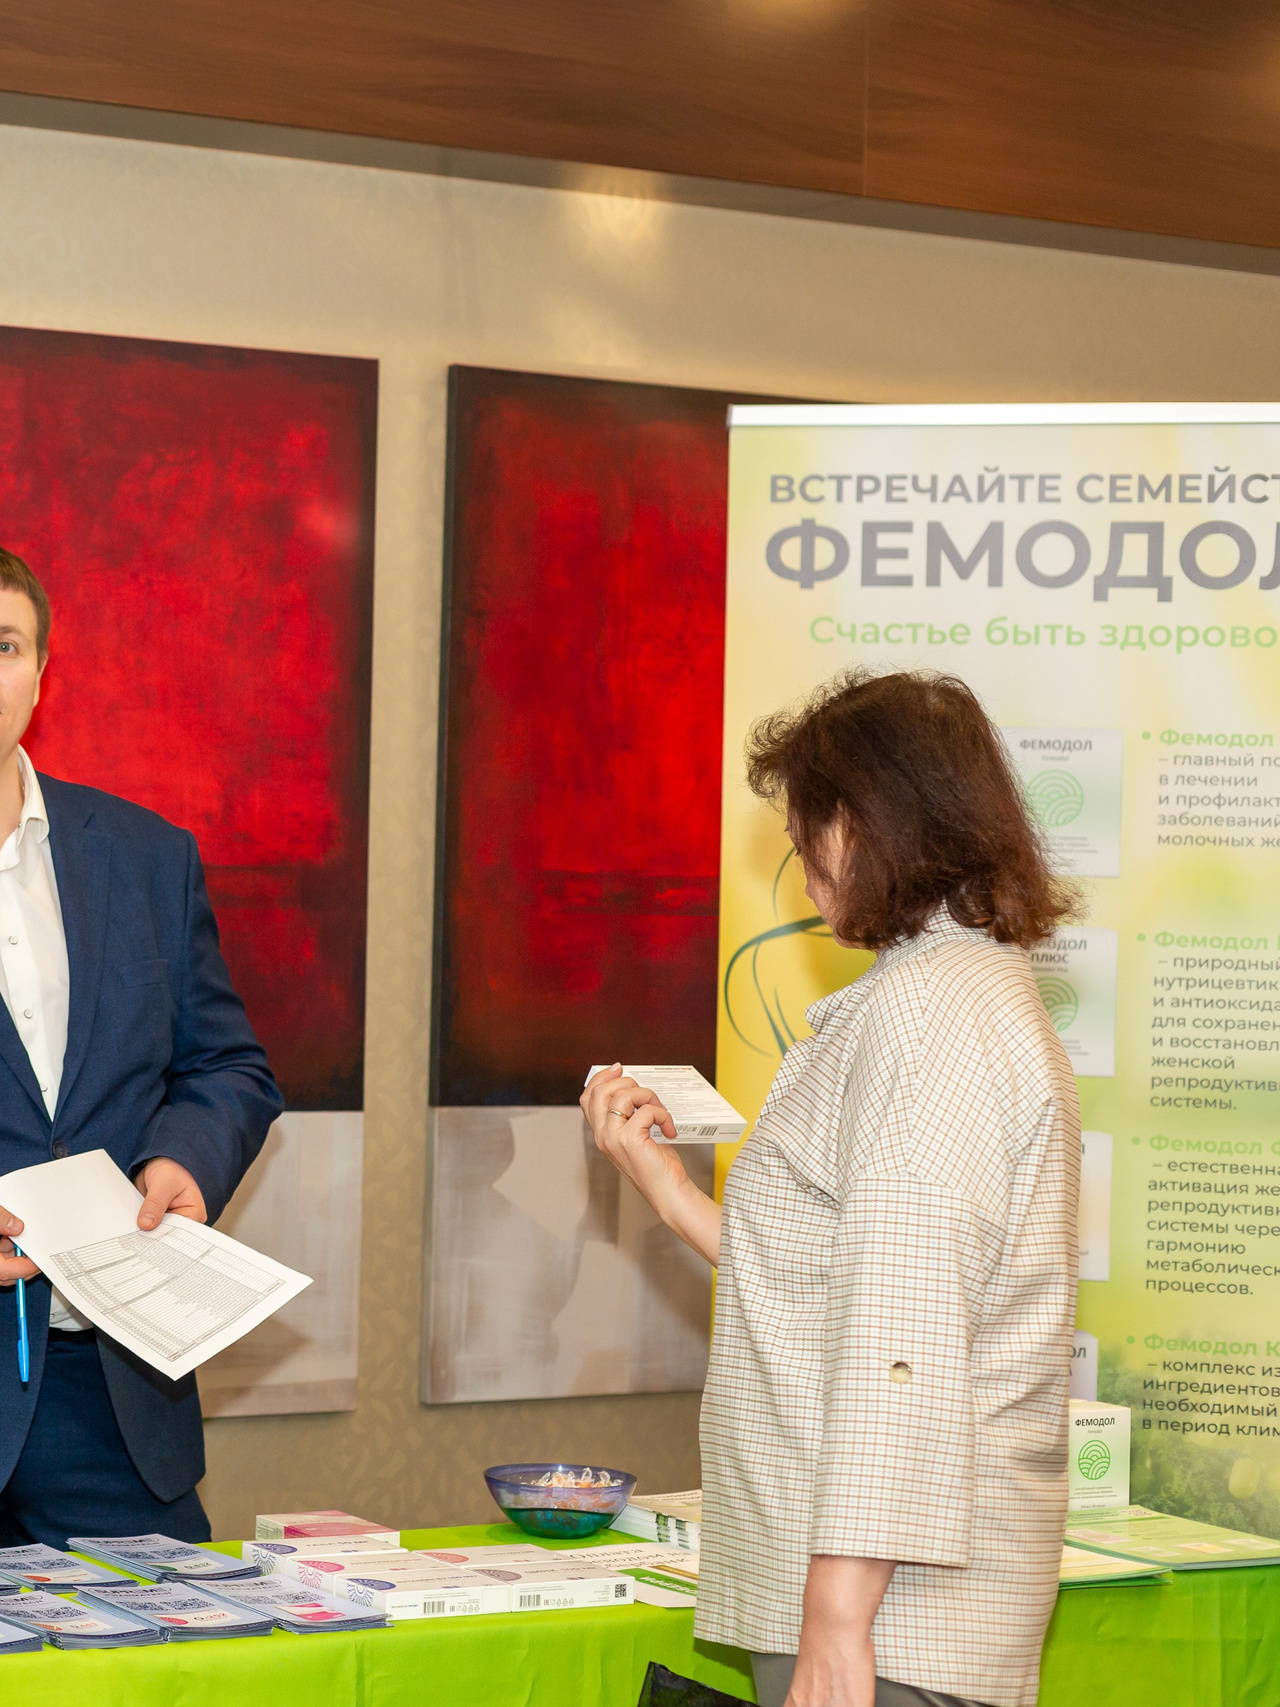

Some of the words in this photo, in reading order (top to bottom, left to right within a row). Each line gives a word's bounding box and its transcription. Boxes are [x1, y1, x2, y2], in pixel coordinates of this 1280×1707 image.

[769, 466, 1062, 504] ВСТРЕЧАЙТЕ
[810, 616, 971, 648] Счастье
[985, 616, 1087, 648] быть
[1099, 623, 1278, 655] здорово
[1020, 738, 1093, 753] ФЕМОДОЛ
[1160, 728, 1274, 748] Фемодол
[1173, 753, 1255, 768] главный
[1159, 775, 1169, 785] в
[1174, 774, 1259, 787] лечении
[1159, 795, 1169, 805] и
[1157, 833, 1255, 848] молочных
[1154, 930, 1268, 952] Фемодол
[1154, 975, 1280, 992] нутрицевтик
[1153, 997, 1164, 1007] и
[1152, 1016, 1187, 1029] для
[1152, 1036, 1163, 1047] и
[1170, 1037, 1280, 1052] восстановл
[1151, 1055, 1236, 1070] женской
[1151, 1074, 1280, 1093] репродуктив
[1150, 1095, 1238, 1110] системы.
[1149, 1134, 1263, 1156] Фемодол
[1148, 1179, 1249, 1196] активация
[1255, 1184, 1280, 1196] же
[1147, 1219, 1229, 1234] системы
[1234, 1223, 1280, 1239] чере
[1147, 1239, 1246, 1255] гармонию
[1146, 1279, 1254, 1295] процессов.
[1143, 1334, 1257, 1356] Фемодол
[1162, 1360, 1256, 1376] комплекс
[1143, 1379, 1280, 1398] ингредиентов
[1143, 1399, 1278, 1417] необходимый
[1075, 1418, 1116, 1427] ФЕМОДОЛ
[1142, 1418, 1152, 1430] в
[1158, 1419, 1230, 1436] период
